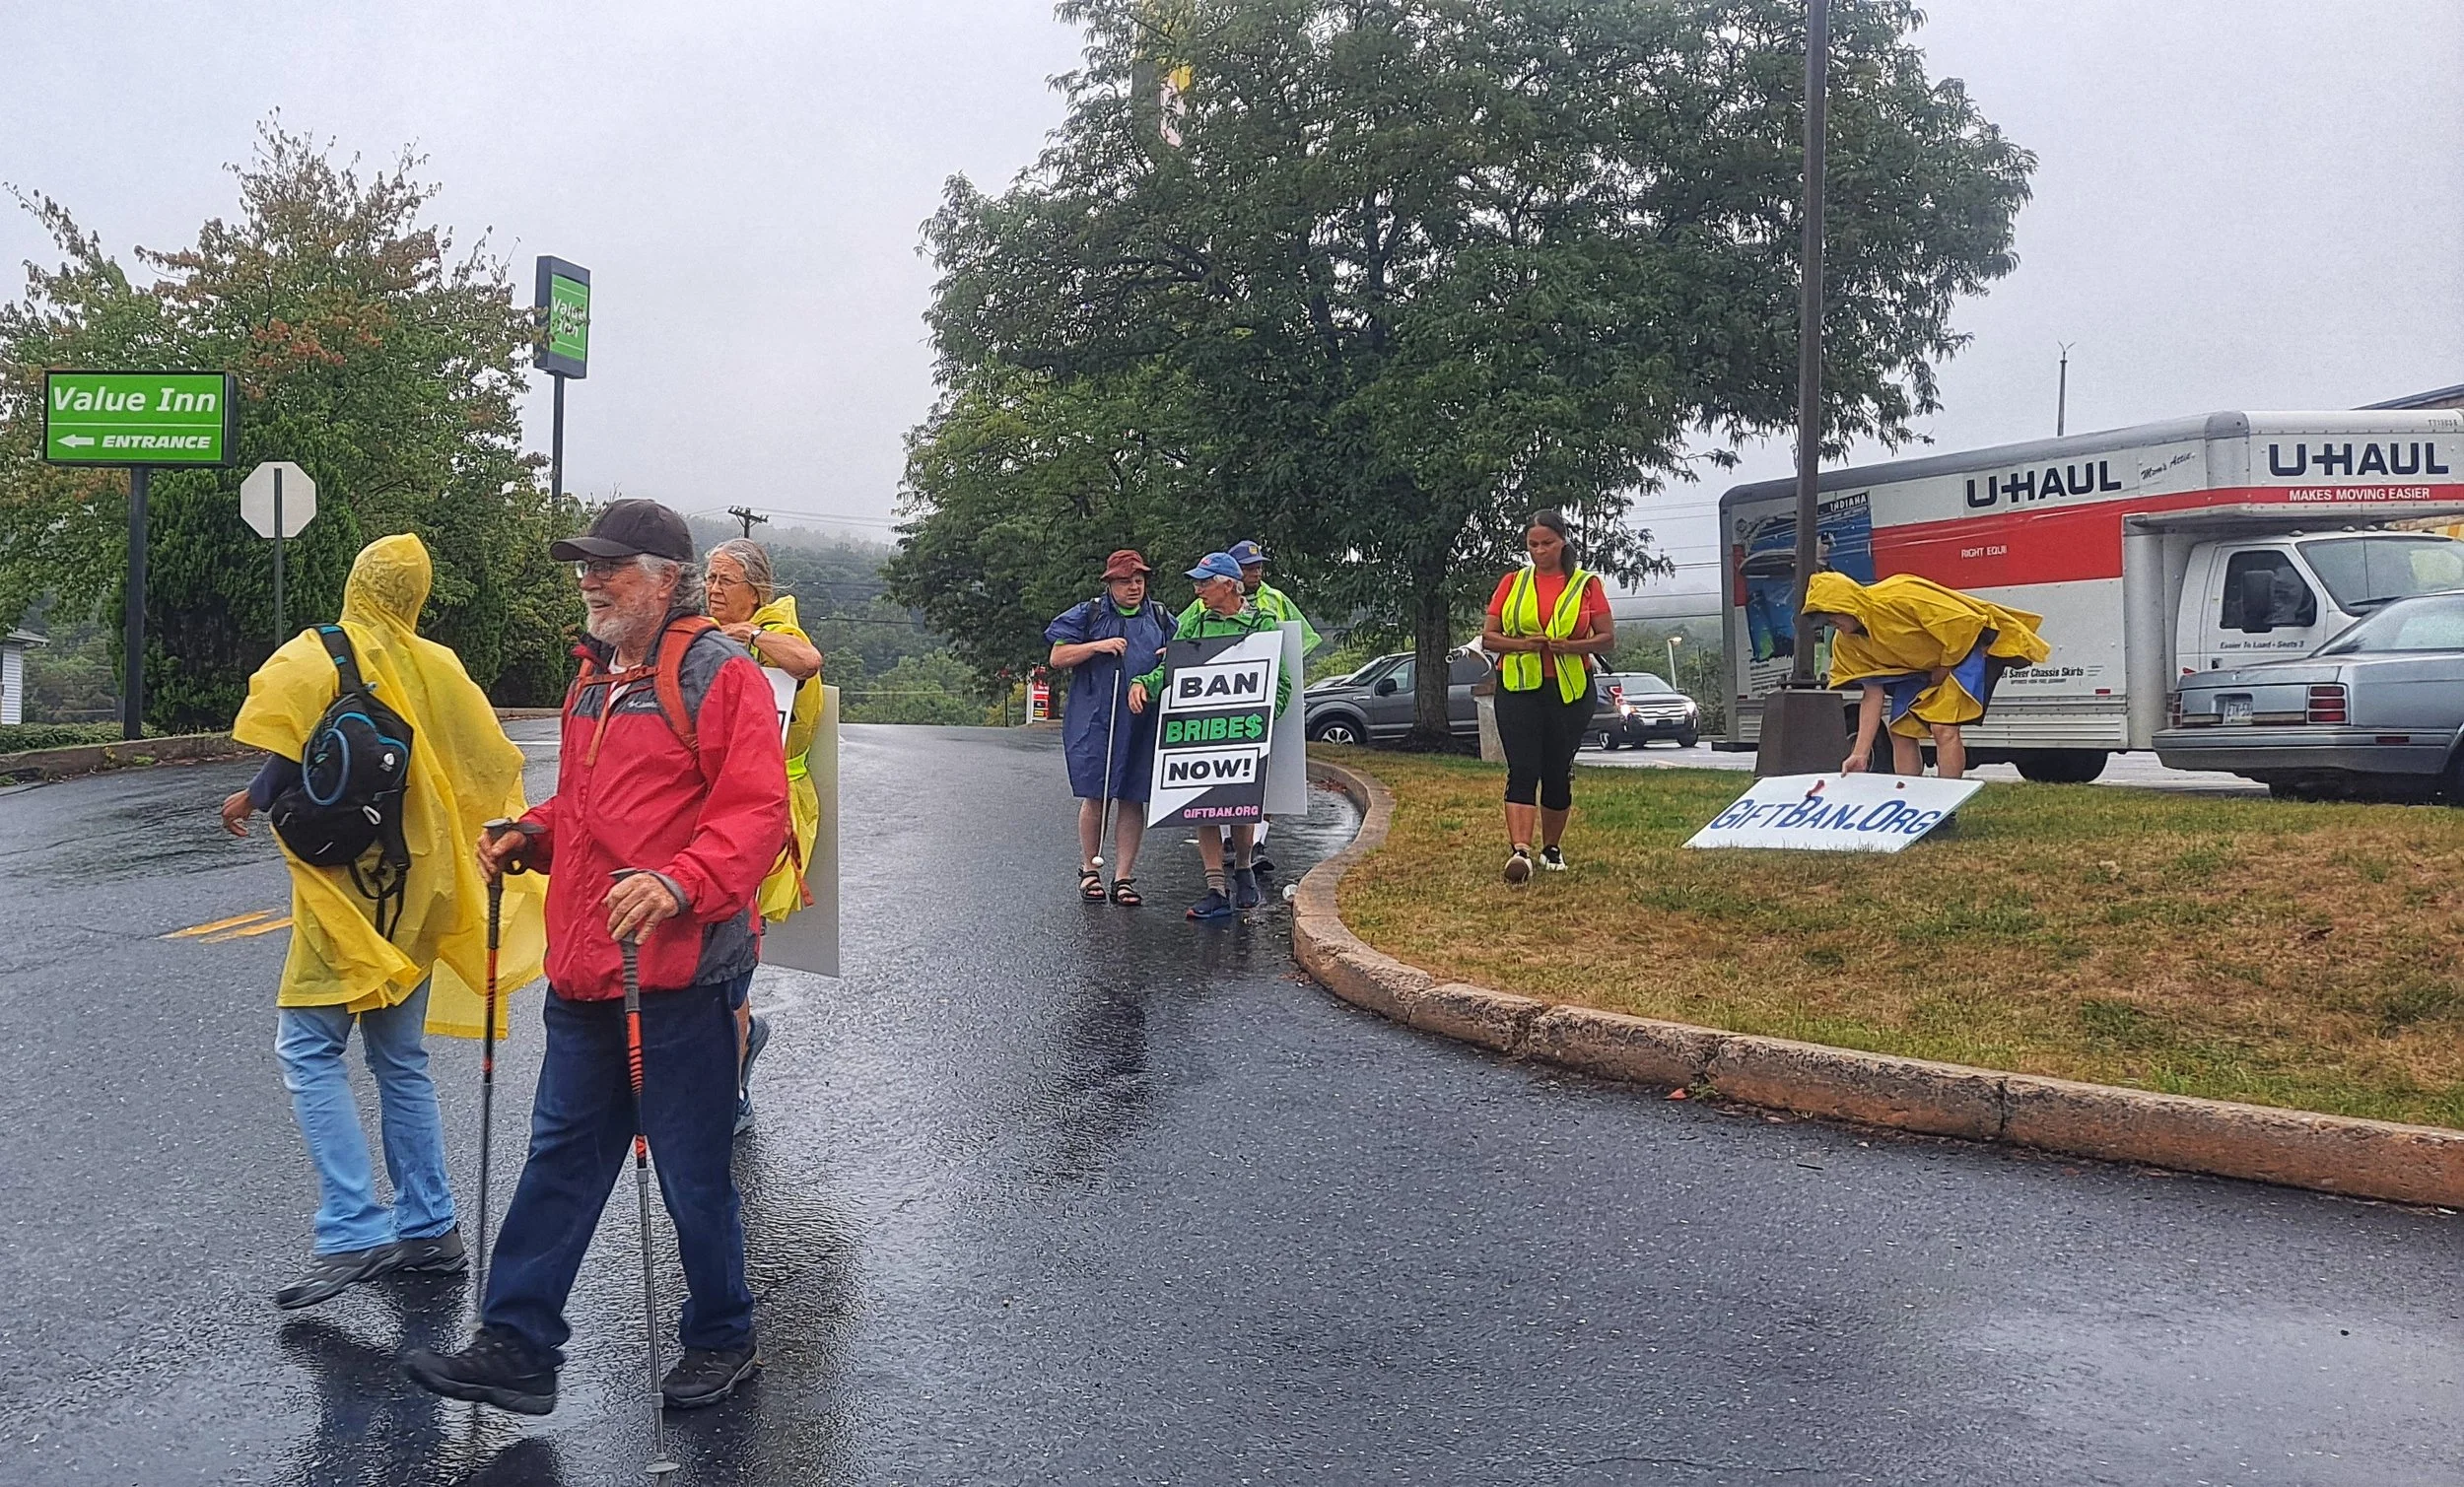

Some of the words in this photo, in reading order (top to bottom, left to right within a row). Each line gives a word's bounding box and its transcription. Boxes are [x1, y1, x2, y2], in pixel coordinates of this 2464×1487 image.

[53, 386, 146, 411] Value
[156, 387, 216, 412] Inn
[102, 436, 212, 449] ENTRANCE
[2289, 490, 2332, 502] MAKES
[2336, 488, 2385, 501] MOVING
[2388, 487, 2430, 500] EASIER
[1829, 494, 1868, 512] INDIANA
[1960, 547, 1984, 559] RIGHT
[2030, 667, 2060, 678] Chassis
[2061, 666, 2084, 676] Skirts
[1179, 671, 1259, 699] BAN
[1165, 712, 1263, 743] BRIBE$
[1168, 758, 1252, 781] NOW!
[1184, 806, 1259, 819] GIFTBAN.ORG
